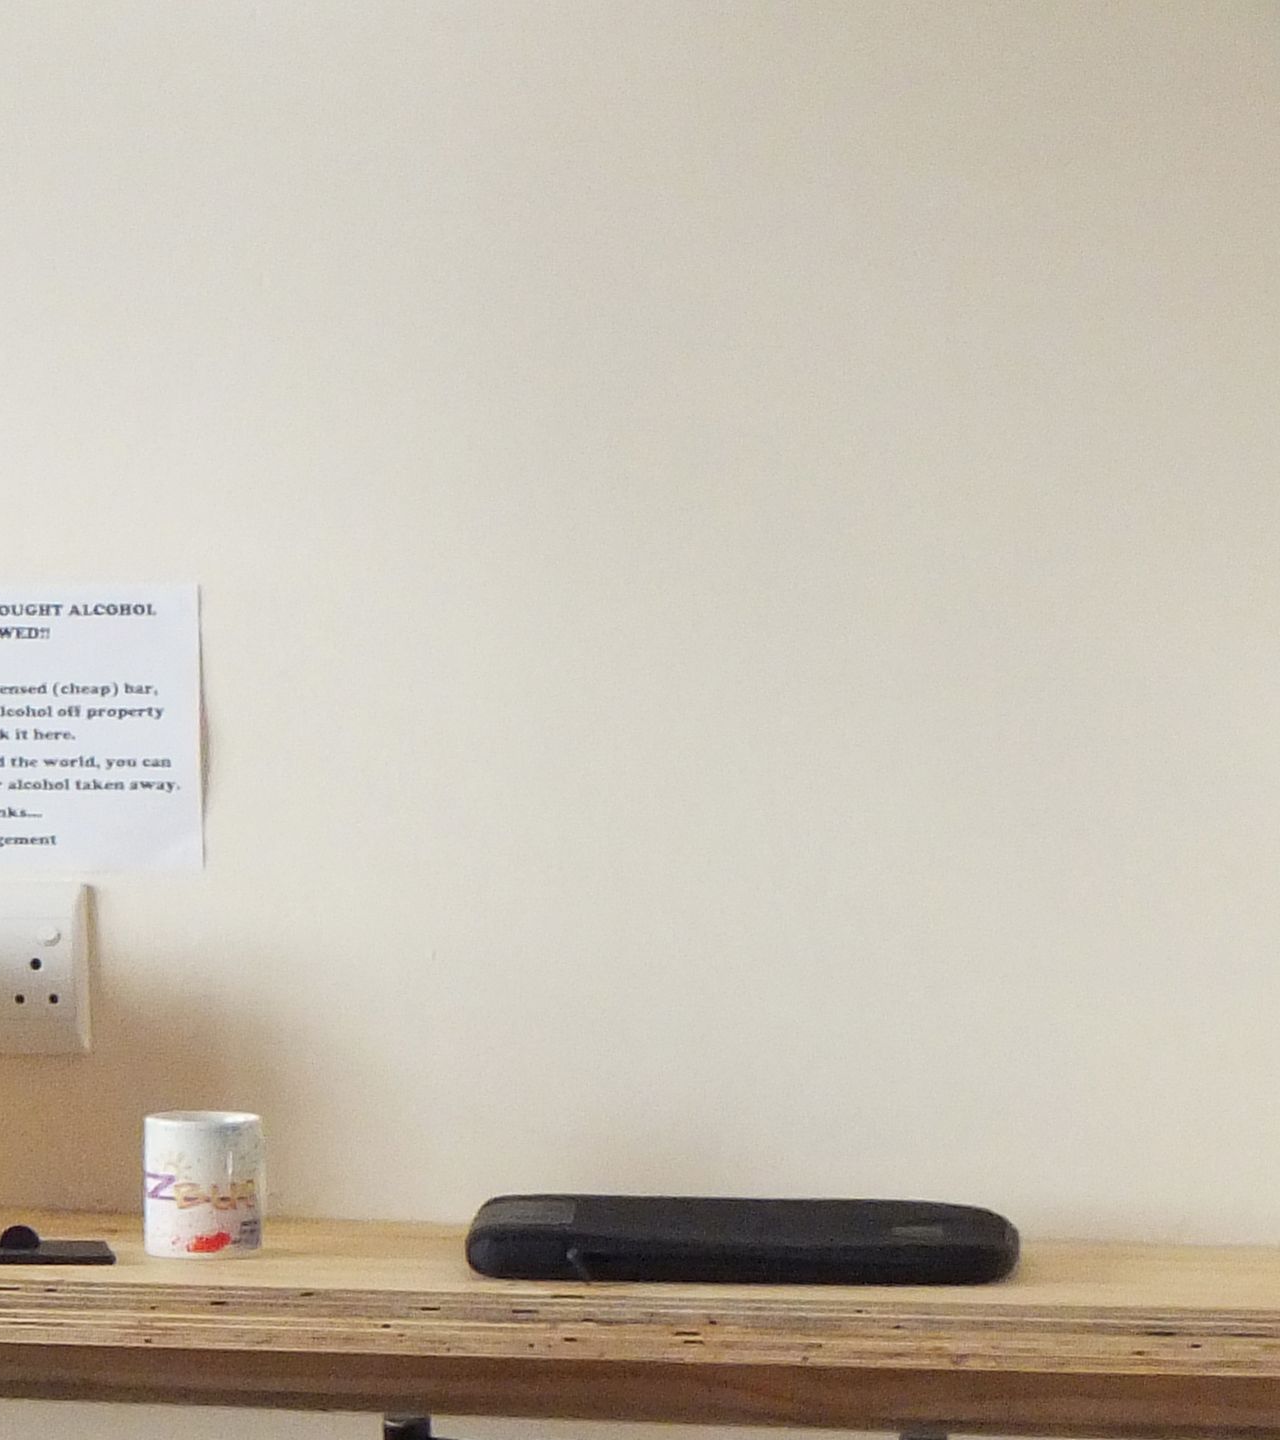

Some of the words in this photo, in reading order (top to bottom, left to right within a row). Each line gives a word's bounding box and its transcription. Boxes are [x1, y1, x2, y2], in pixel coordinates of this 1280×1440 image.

[67, 602, 158, 617] ALCOHOL
[51, 681, 120, 698] (cheap)
[56, 704, 82, 718] off
[85, 706, 165, 721] property
[14, 727, 29, 741] it
[32, 727, 76, 741] here.
[9, 755, 39, 769] the
[42, 755, 101, 770] world,
[105, 758, 138, 771] you
[141, 758, 172, 769] can
[7, 777, 70, 792] alcohol
[74, 778, 126, 791] taken
[128, 780, 181, 794] away.
